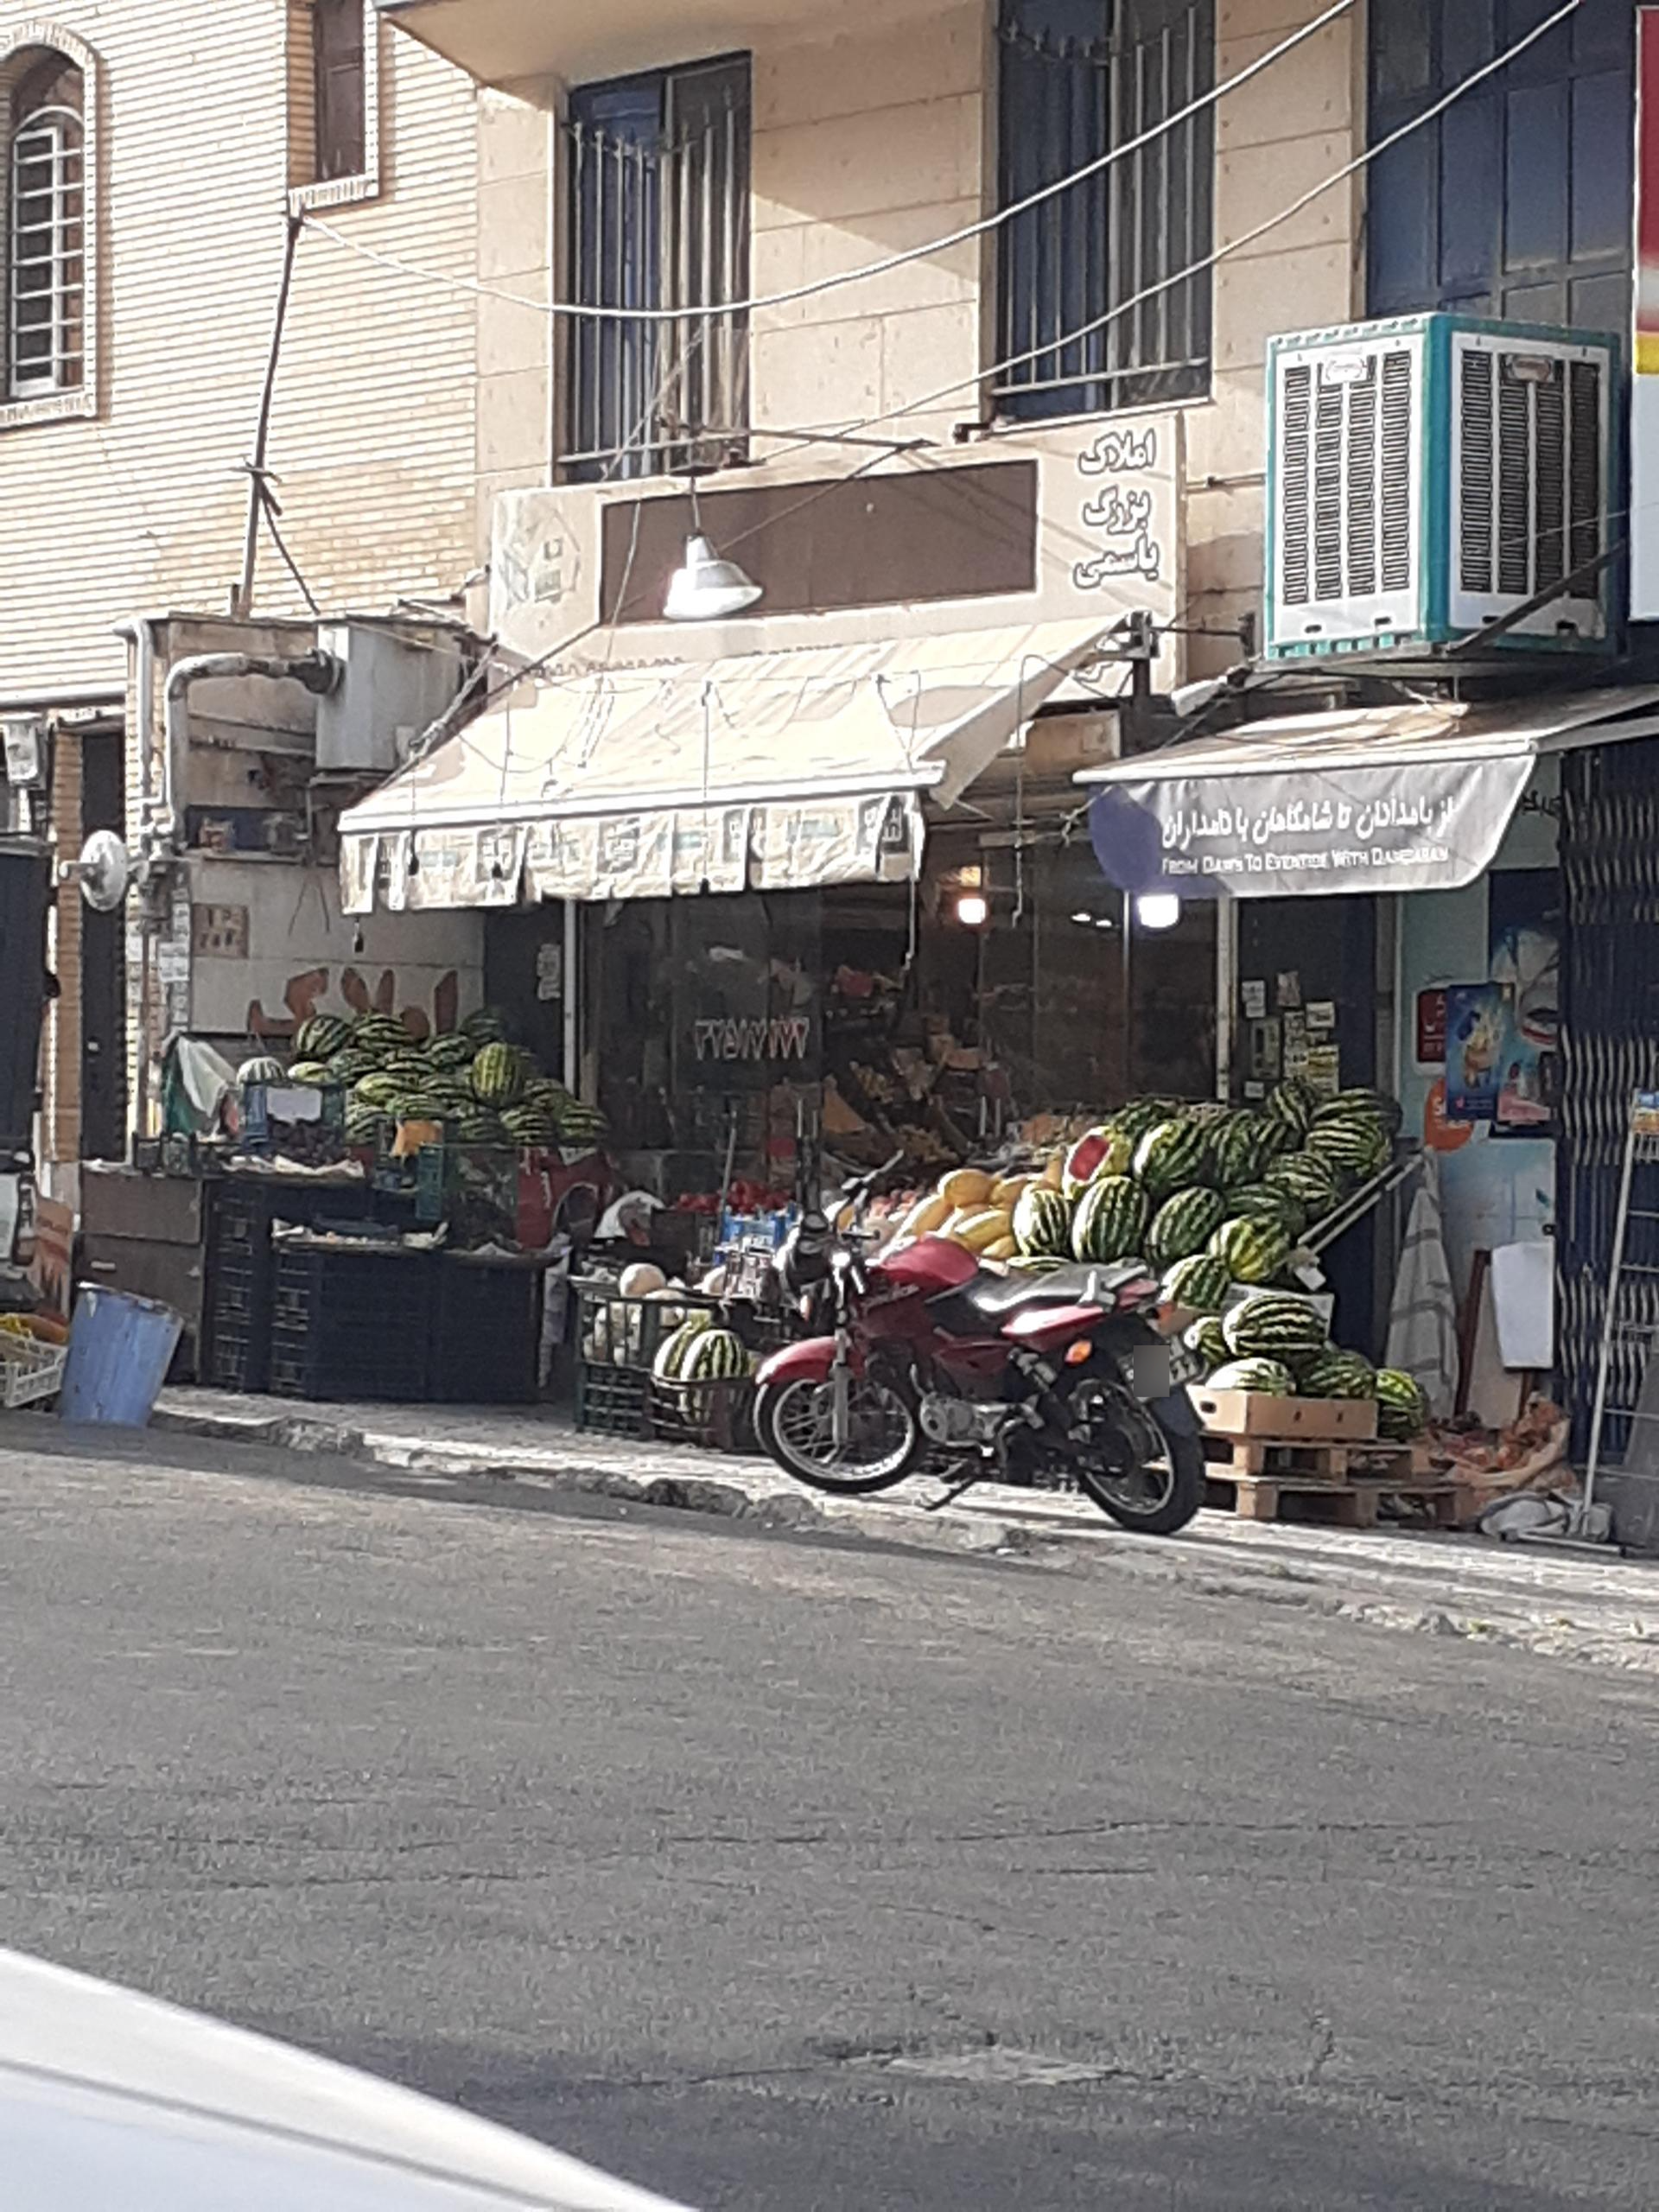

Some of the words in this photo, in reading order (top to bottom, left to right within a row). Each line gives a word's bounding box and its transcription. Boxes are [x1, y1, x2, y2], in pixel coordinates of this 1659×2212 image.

[1078, 428, 1156, 475] املاک
[1161, 807, 1233, 851] دامداران
[1235, 807, 1249, 842] با
[1252, 799, 1333, 845] شامگاهان
[1337, 800, 1352, 830] تا
[1355, 795, 1433, 840] بامدادان
